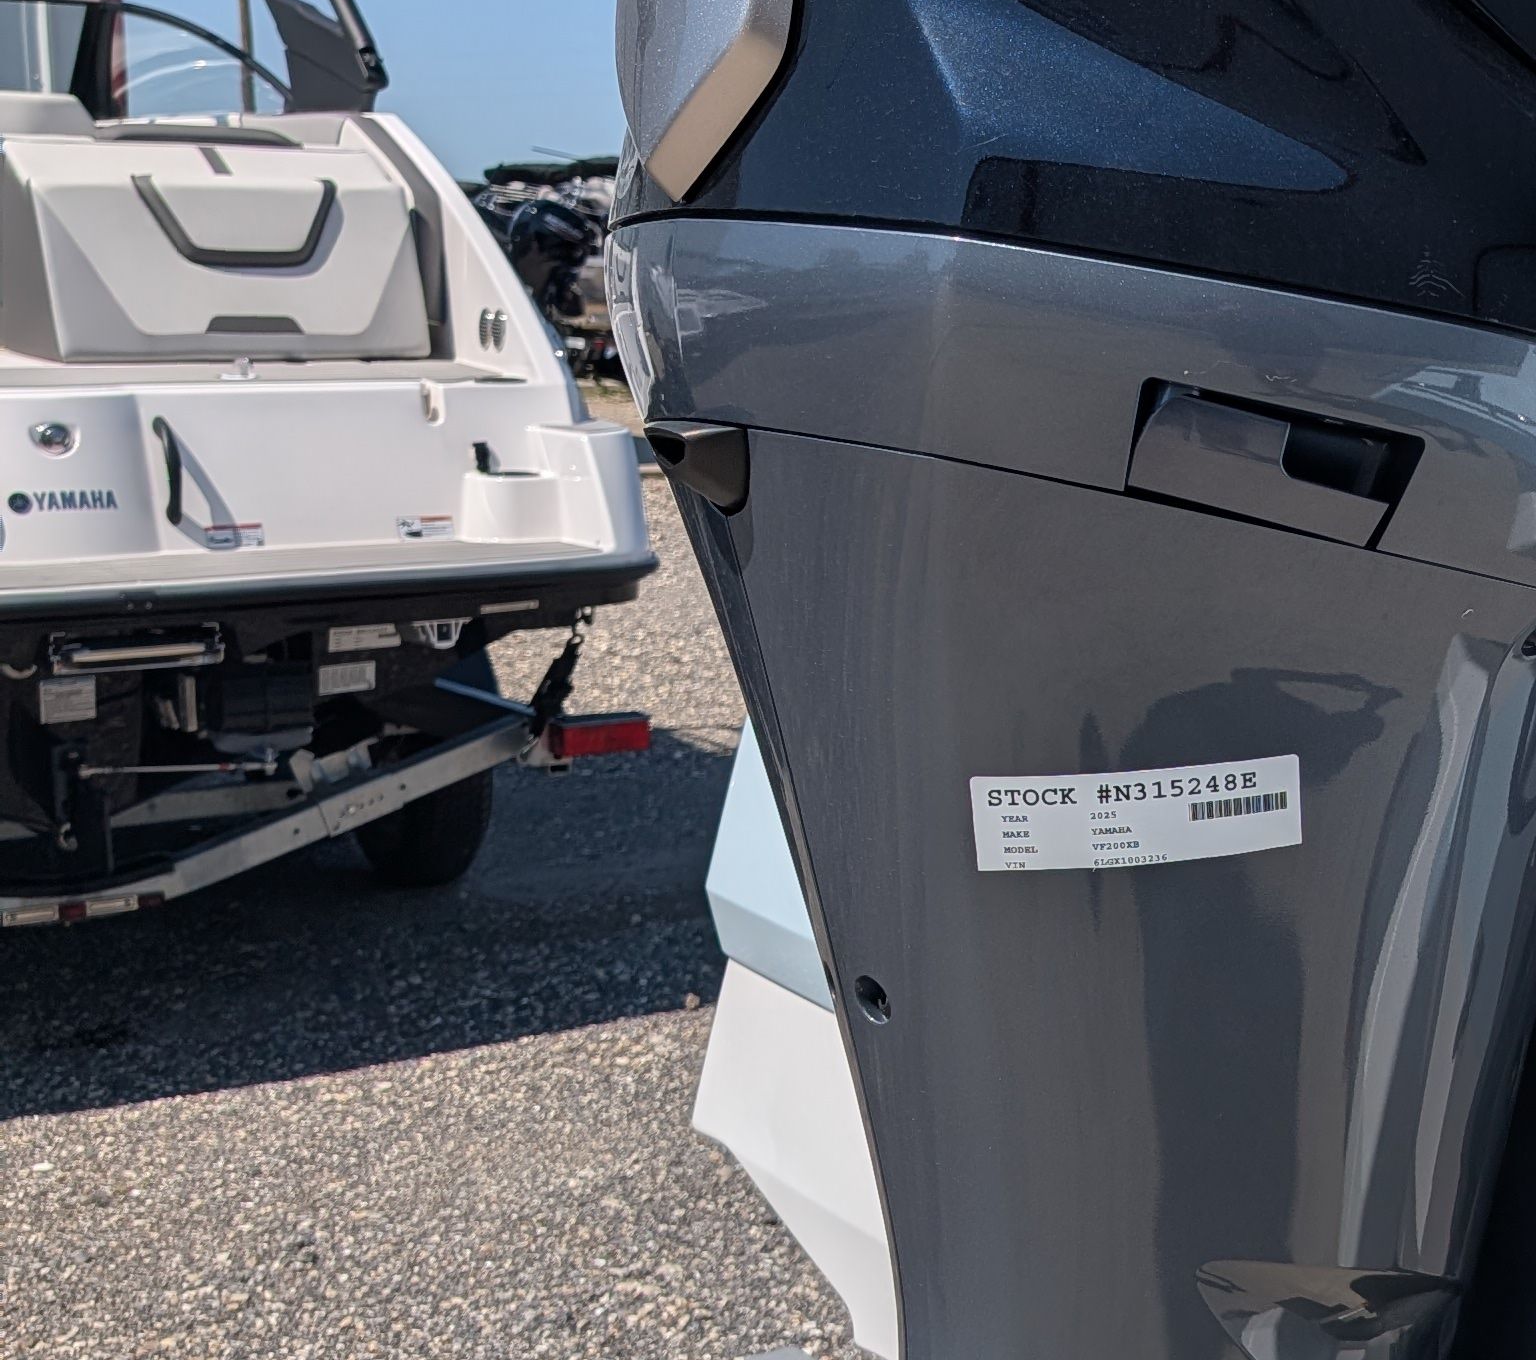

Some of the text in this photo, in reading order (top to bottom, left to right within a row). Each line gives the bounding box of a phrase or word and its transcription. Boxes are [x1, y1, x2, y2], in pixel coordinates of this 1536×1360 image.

[33, 490, 117, 511] YAMAHA
[988, 771, 1257, 807] STOCK #N315248E
[1001, 810, 1117, 824] YEAR 2025
[1002, 825, 1132, 839] MAKE YAMAHA
[1004, 841, 1140, 854] MODEL VF200XB
[1005, 861, 1026, 870] VIN
